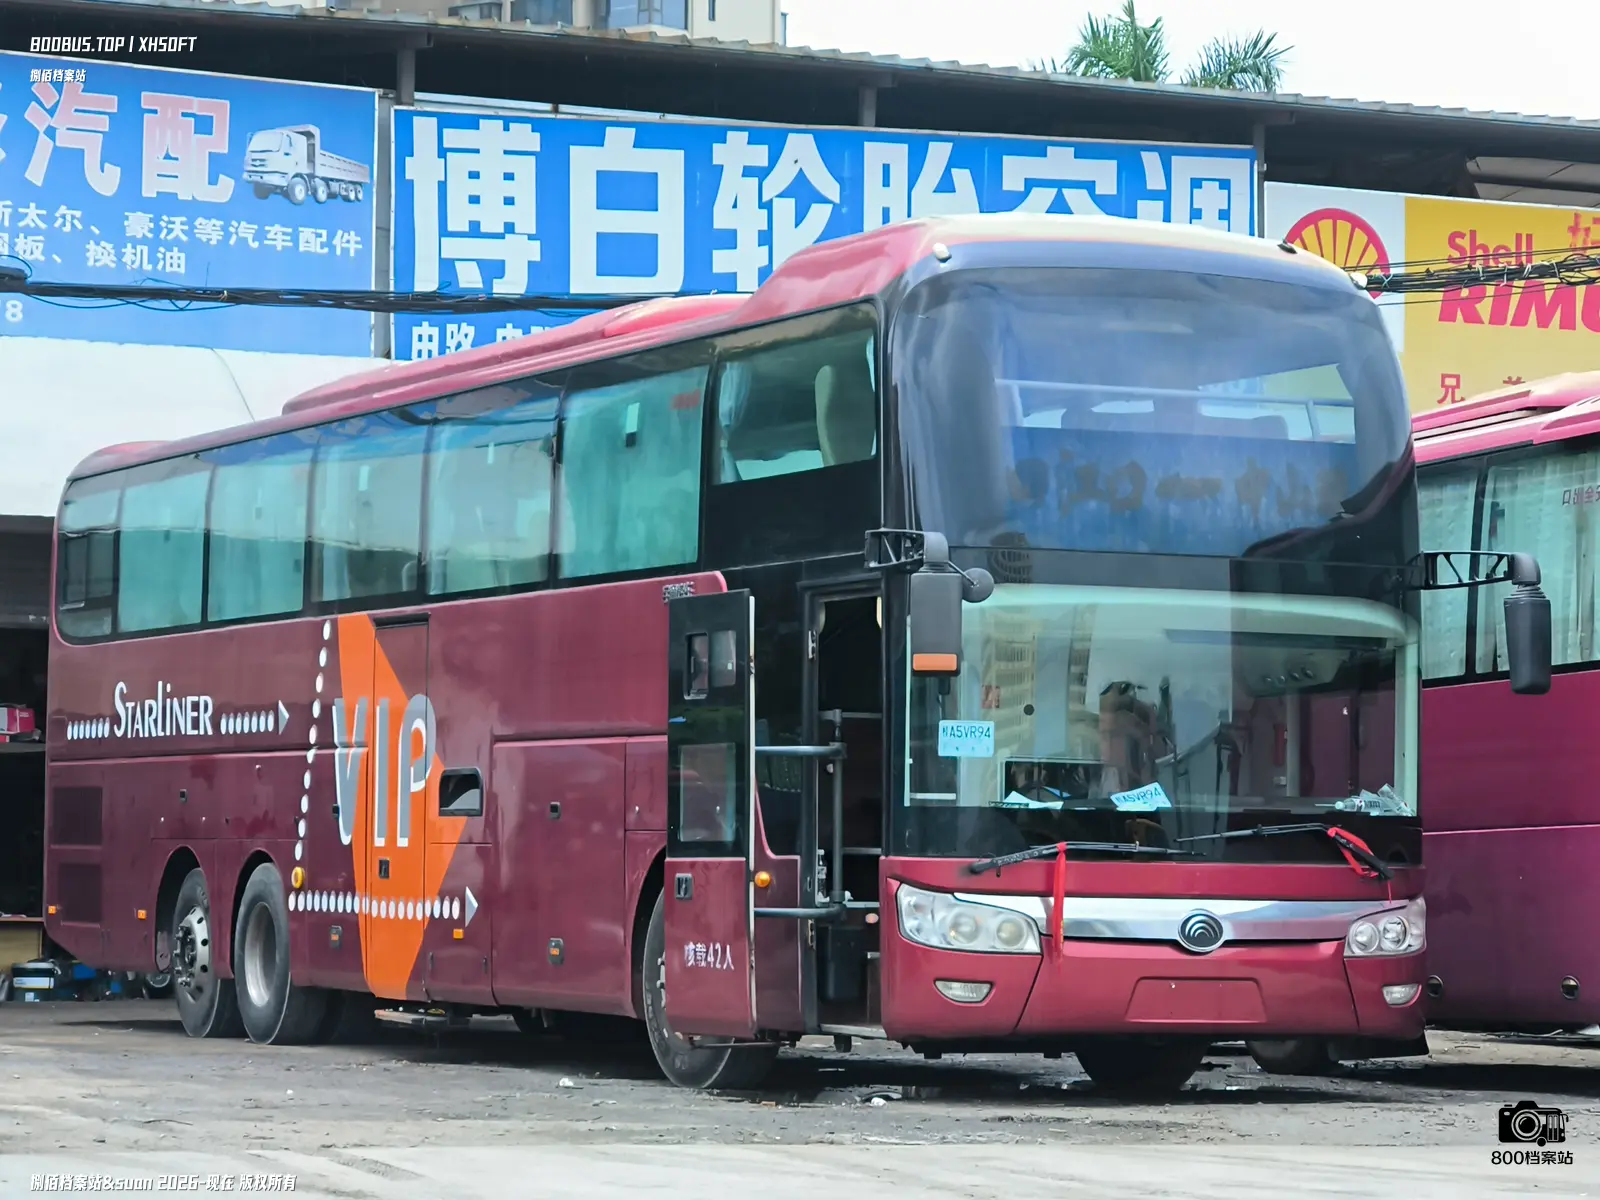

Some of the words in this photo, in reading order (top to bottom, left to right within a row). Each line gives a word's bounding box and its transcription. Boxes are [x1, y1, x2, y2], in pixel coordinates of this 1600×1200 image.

[0, 80, 236, 204] 汽配
[1447, 229, 1534, 267] Shell
[331, 693, 437, 849] VIP
[1116, 787, 1162, 805] A5VR94
